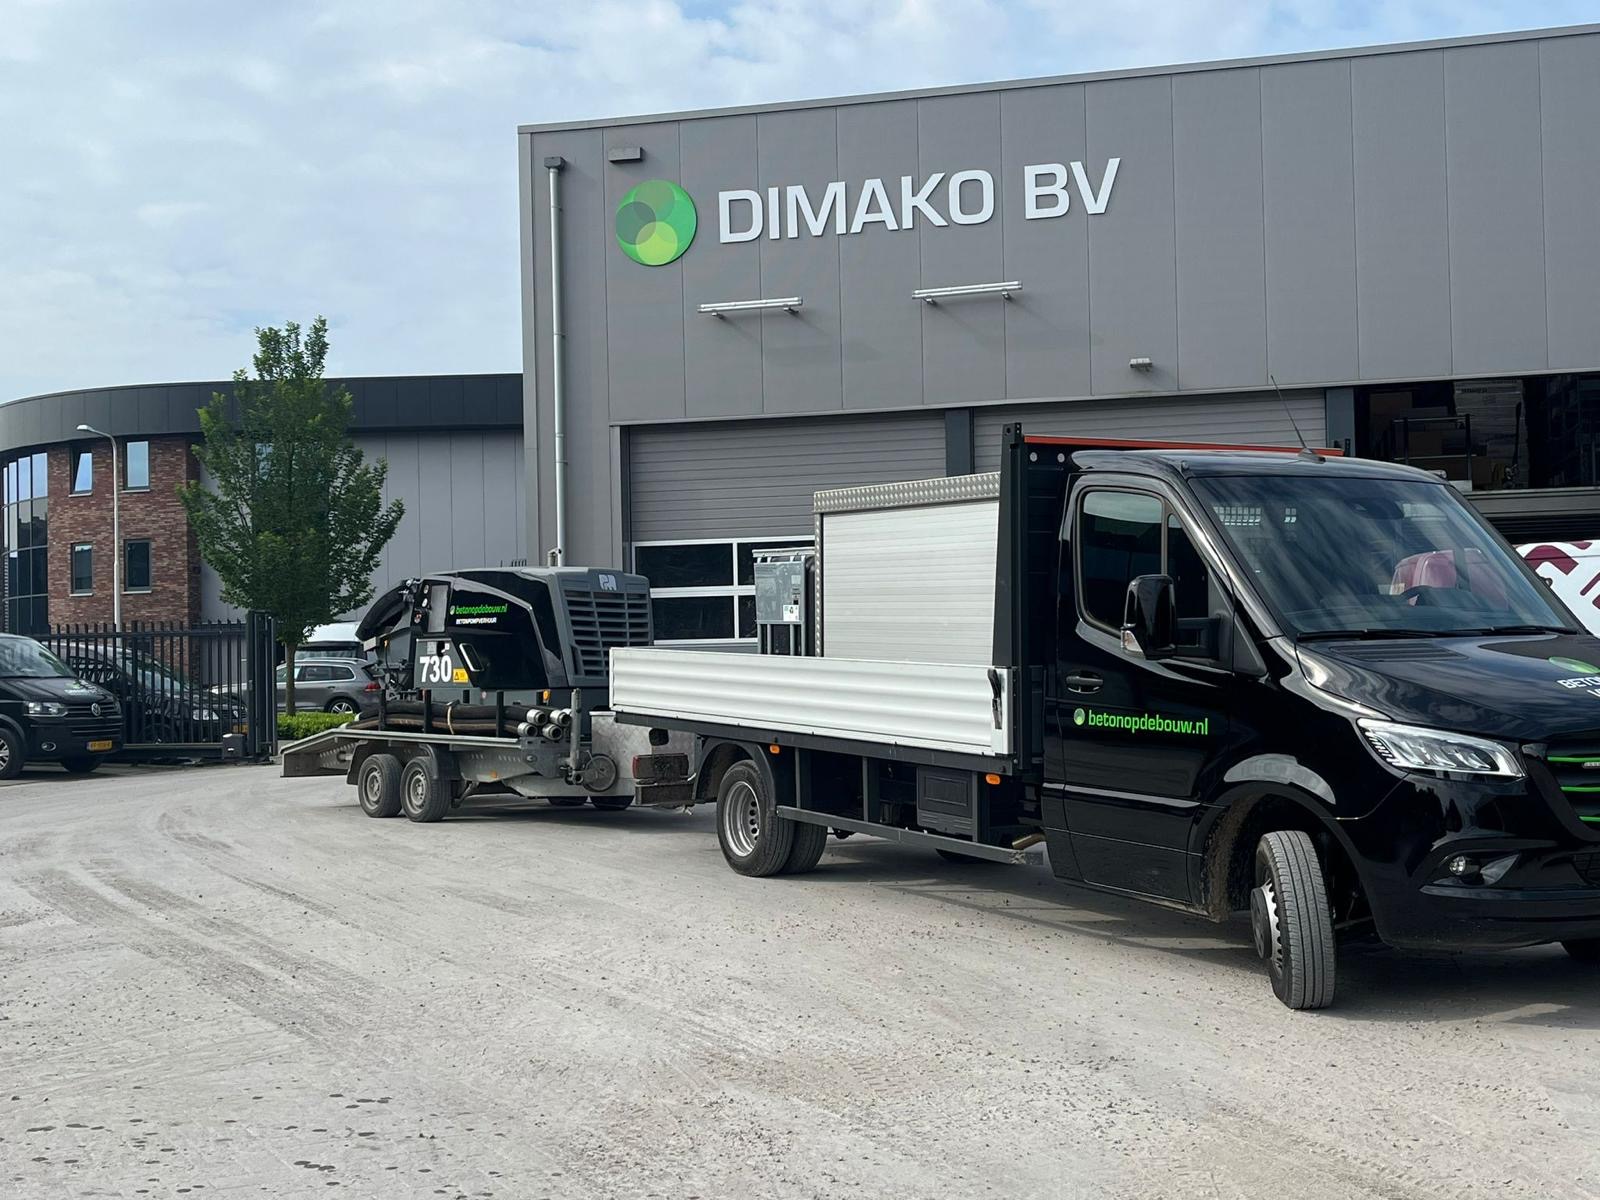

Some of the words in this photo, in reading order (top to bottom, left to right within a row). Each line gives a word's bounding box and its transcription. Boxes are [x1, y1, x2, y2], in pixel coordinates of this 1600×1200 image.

[718, 169, 995, 244] DIMAKO
[1023, 157, 1121, 220] BV
[456, 603, 508, 616] betonopdebouw.nl
[419, 655, 452, 683] 730
[1088, 709, 1209, 736] betonopdebouw.nl
